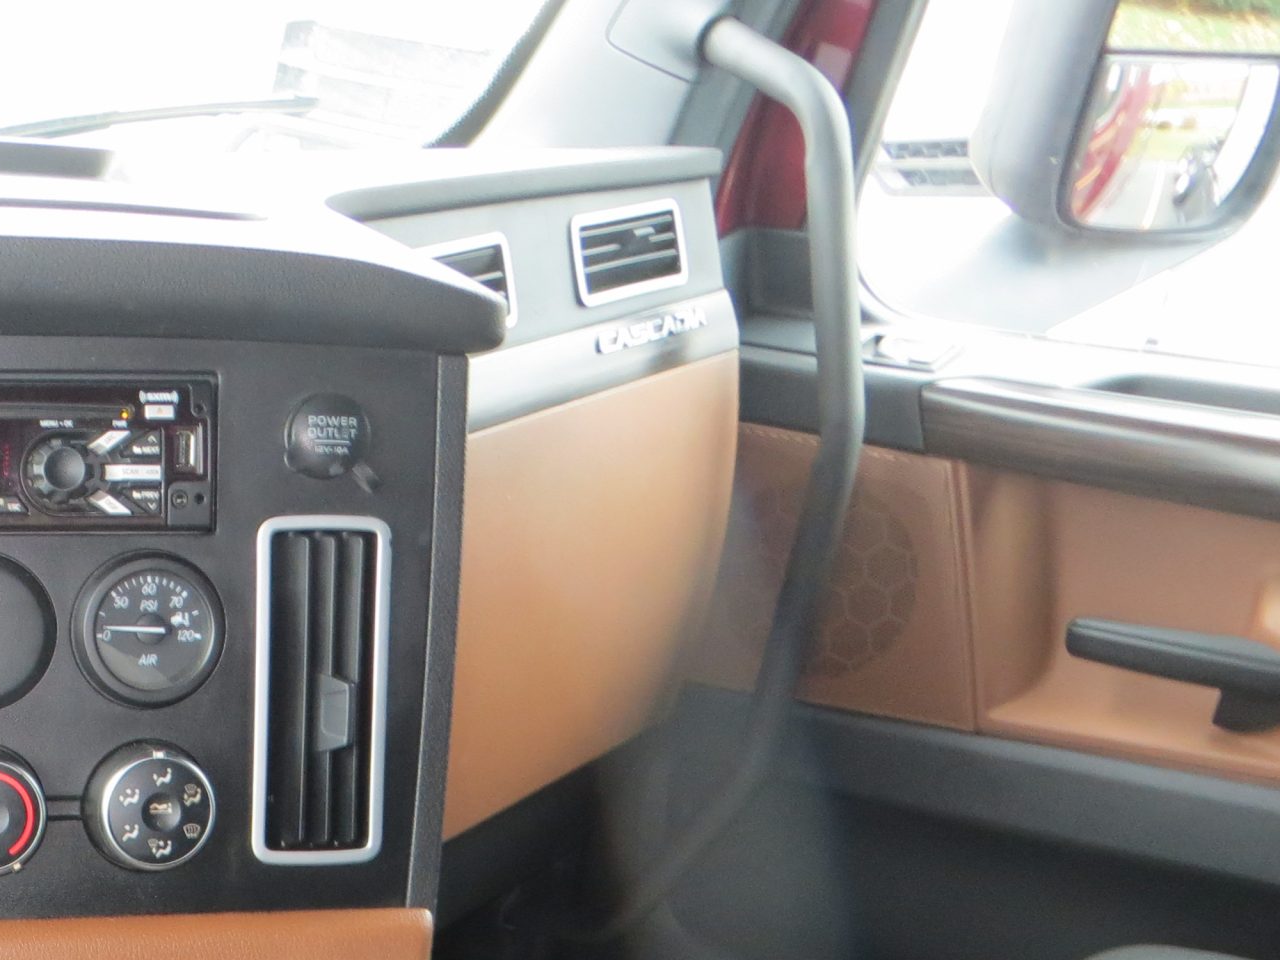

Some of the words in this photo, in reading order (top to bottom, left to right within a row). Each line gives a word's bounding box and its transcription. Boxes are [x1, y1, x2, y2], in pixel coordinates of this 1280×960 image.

[307, 415, 358, 428] POWER
[307, 427, 357, 440] OUTLET
[141, 583, 158, 596] 60
[140, 600, 160, 612] PSI
[102, 629, 112, 642] 0
[177, 629, 195, 642] 120
[138, 653, 159, 666] AIR
